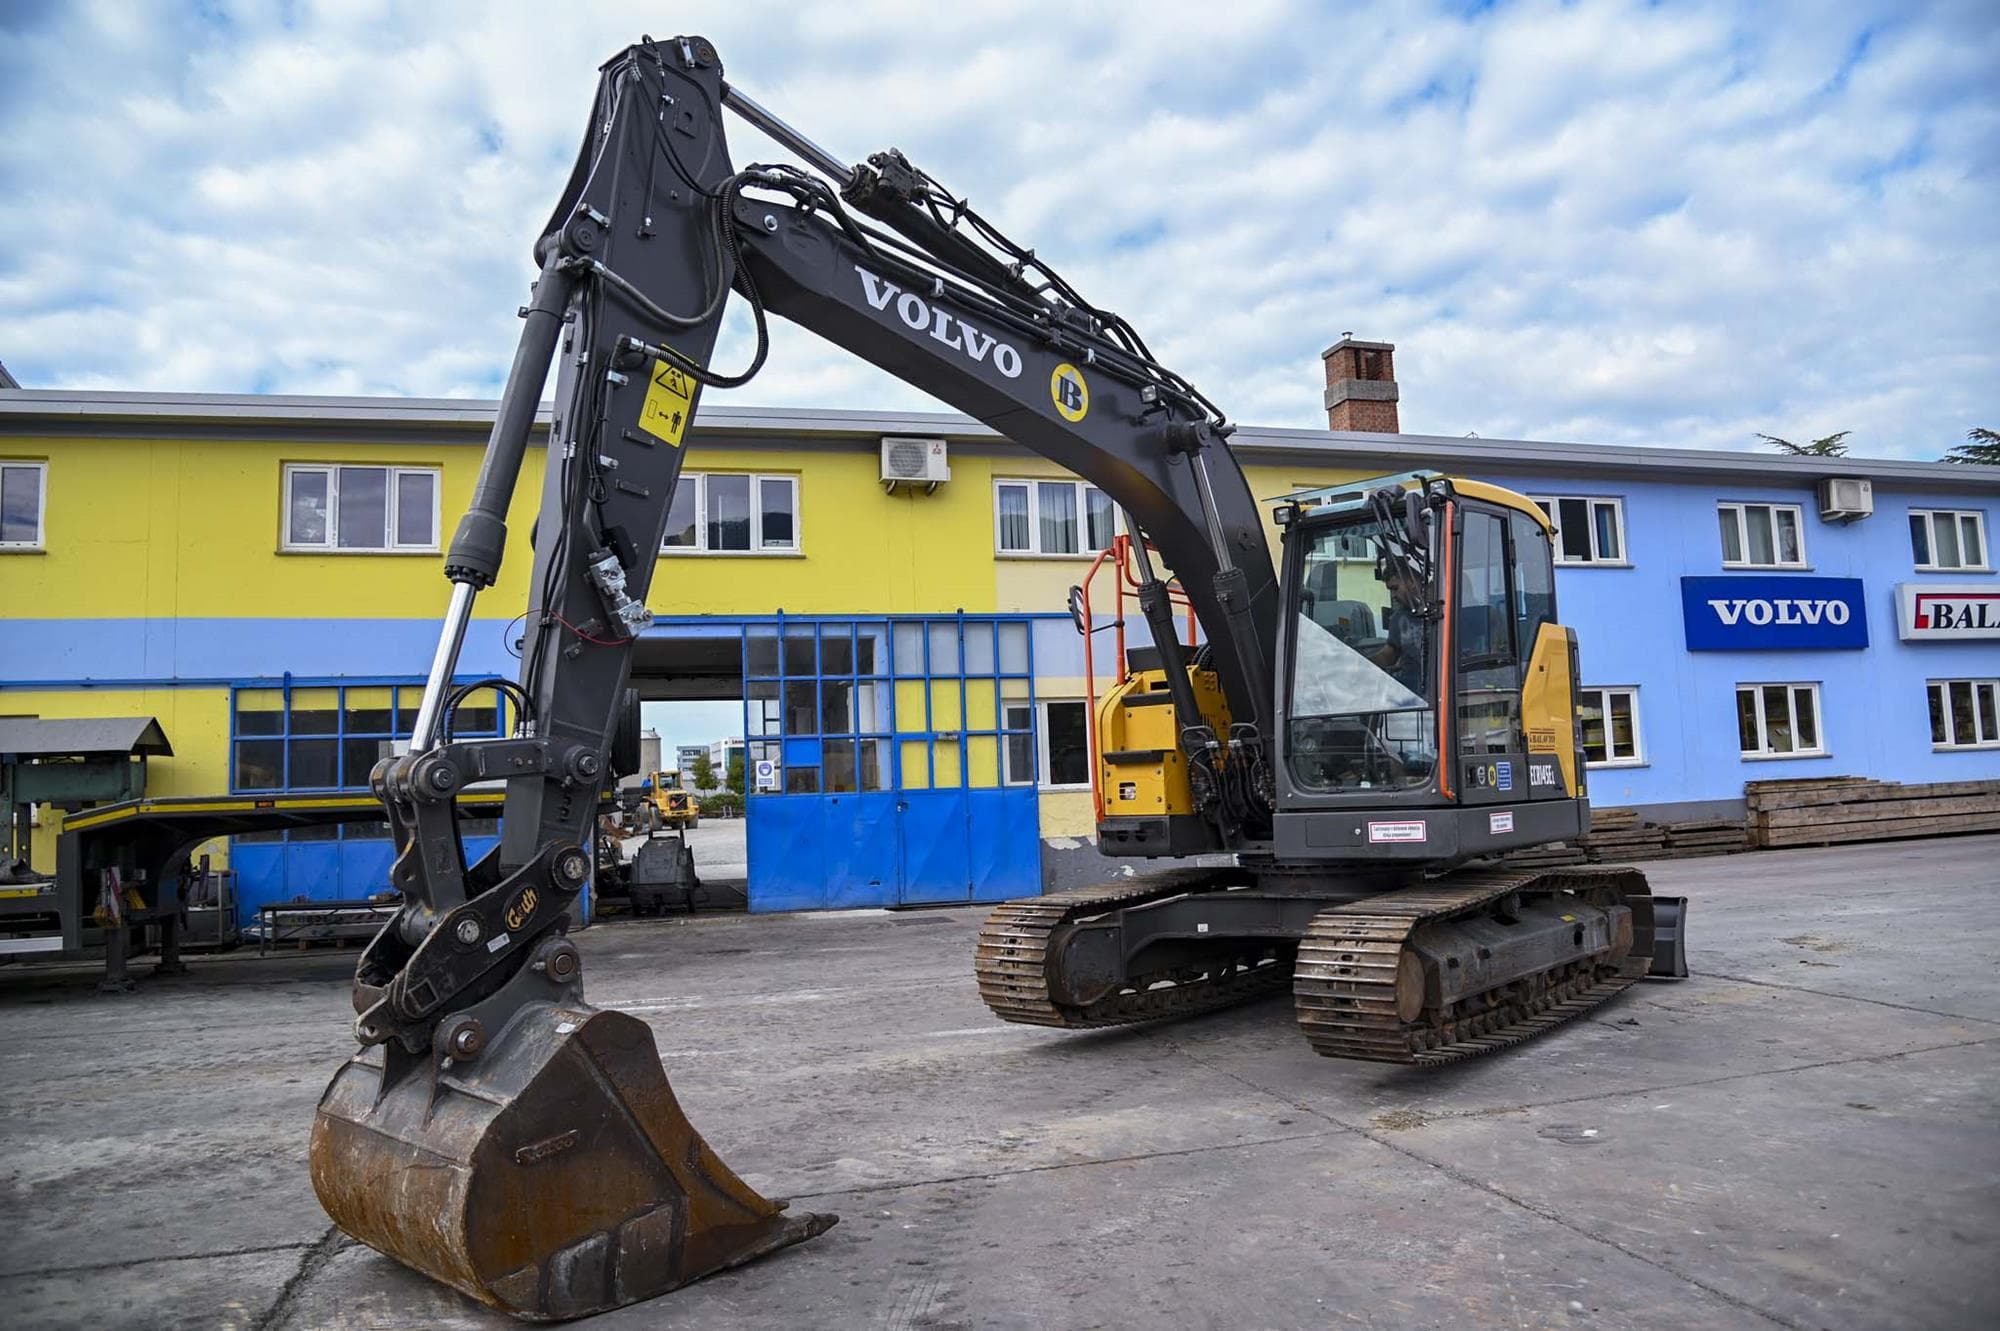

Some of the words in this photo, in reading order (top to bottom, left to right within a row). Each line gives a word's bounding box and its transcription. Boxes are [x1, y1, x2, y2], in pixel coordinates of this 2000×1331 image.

[854, 265, 1023, 379] VOLVO
[1707, 599, 1850, 625] VOLVO
[1930, 603, 2000, 629] BAL
